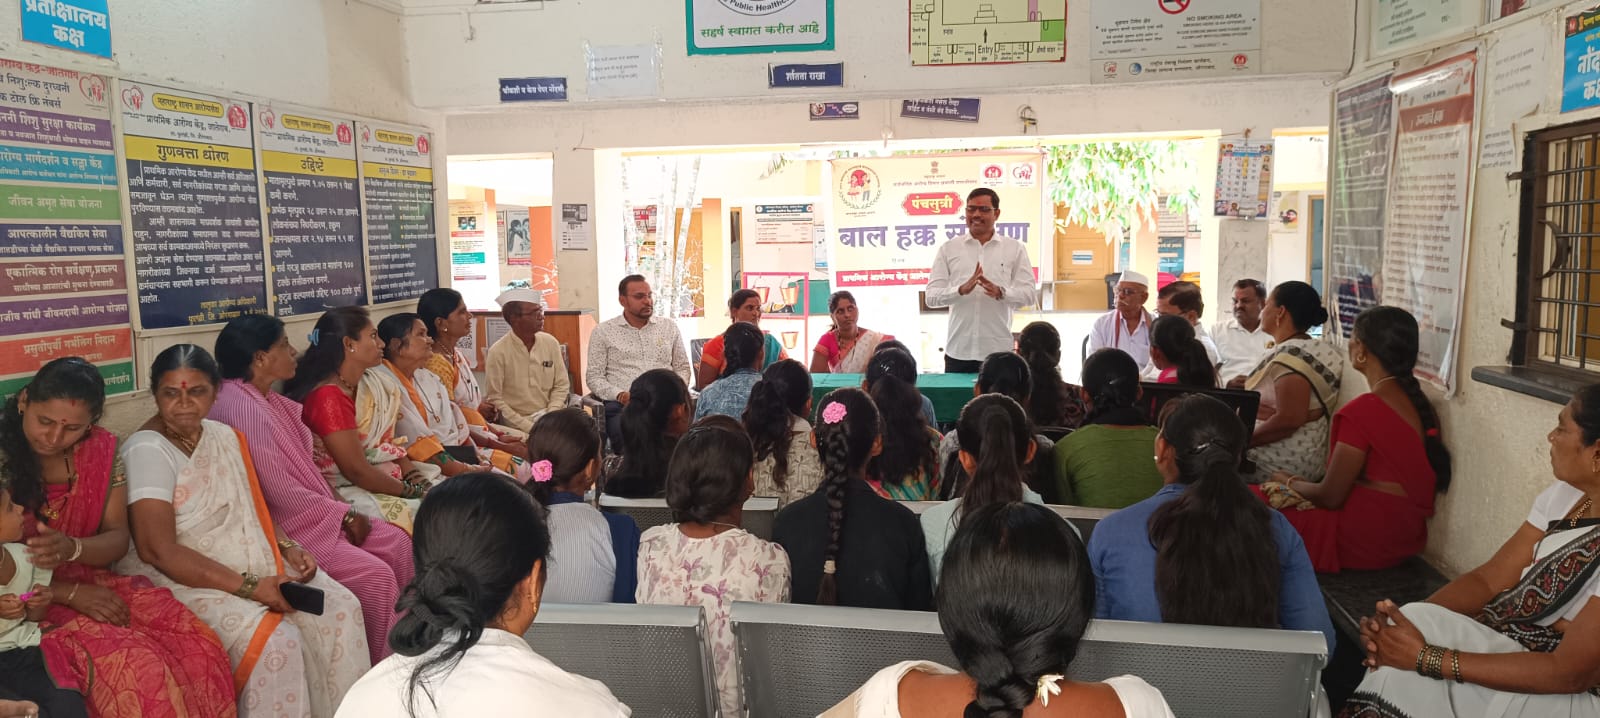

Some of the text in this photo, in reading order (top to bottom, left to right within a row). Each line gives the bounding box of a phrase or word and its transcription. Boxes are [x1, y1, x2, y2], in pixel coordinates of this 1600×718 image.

[52, 24, 85, 48] कक्ष
[701, 21, 819, 38] सहर्ष स्वागत करीत आहे
[978, 45, 993, 56] Entry
[808, 71, 826, 81] राखा
[10, 90, 26, 103] टोल
[0, 110, 96, 132] ननी शिशु सुरक्षा कार्यक्रम
[146, 114, 171, 126] प्राथमिक
[173, 116, 193, 128] आरोग्य
[24, 151, 59, 166] मार्गदर्शन
[62, 157, 69, 166] व
[156, 144, 229, 162] गुणवत्ता धोरण
[144, 164, 167, 176] प्राथमिक
[168, 166, 186, 177] आरोग्य
[129, 176, 143, 187] आणि
[8, 193, 102, 212] जीवन अमृत सेवा योजना
[911, 194, 953, 213] पंचसुत्री
[8, 226, 57, 239] आपत्कालीन
[92, 226, 107, 239] सेवा
[838, 225, 888, 249] बाल
[895, 225, 938, 251] हक्क
[6, 263, 47, 280] एकात्मिक
[49, 263, 63, 275] रोग
[22, 307, 41, 321] गांधी
[43, 305, 79, 319] जीवनदायी
[82, 303, 105, 316] आरोग्य
[106, 302, 128, 313] योजना
[95, 332, 116, 346] निदान
